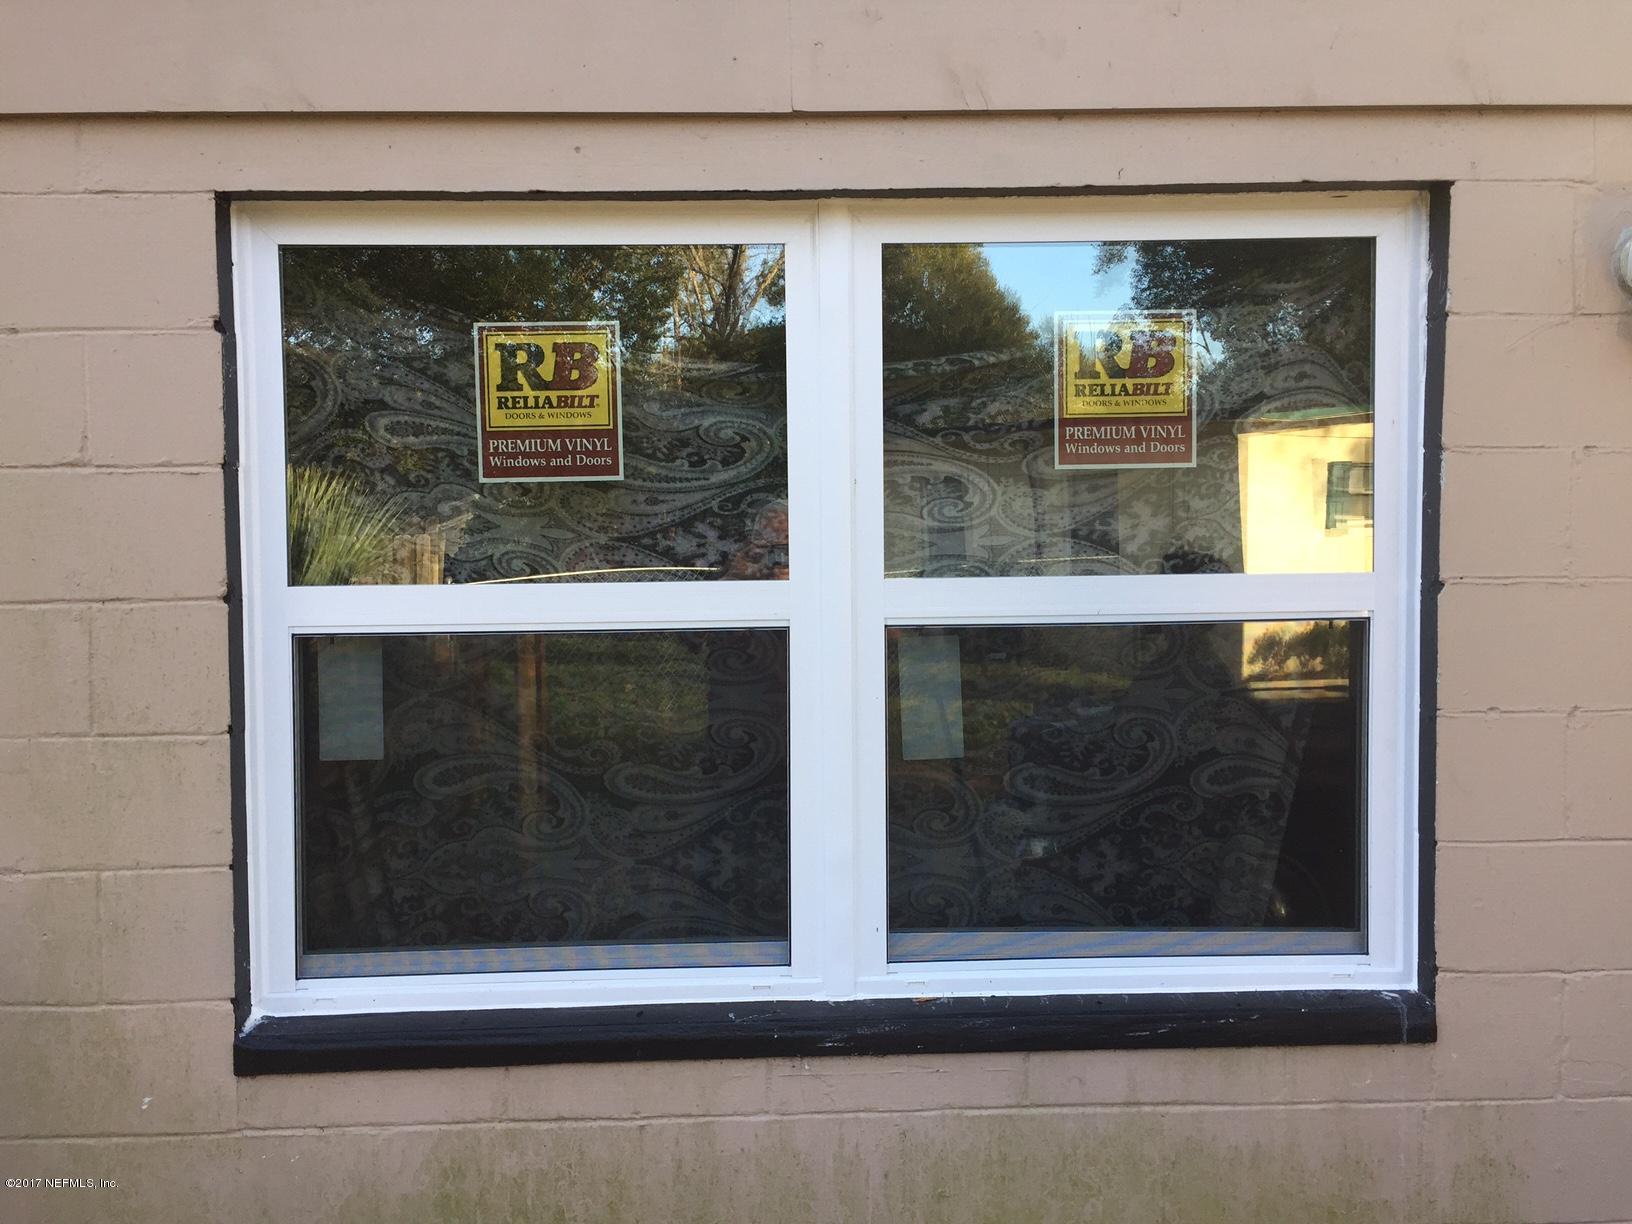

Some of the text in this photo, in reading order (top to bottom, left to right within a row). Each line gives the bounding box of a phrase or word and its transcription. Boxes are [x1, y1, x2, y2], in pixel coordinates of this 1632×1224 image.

[1074, 330, 1177, 380] RB
[495, 341, 600, 392] RB
[1074, 382, 1173, 398] RELIABILT
[496, 394, 599, 410] RELIABILT
[1122, 399, 1167, 407] WINDOWS
[505, 412, 536, 420] DOORS
[547, 411, 592, 419] WINDOWS
[1065, 425, 1185, 440] PREMIUM VINYL
[489, 438, 612, 453] PREMIUM VINYL
[1065, 441, 1185, 454] Windows and Doors
[489, 454, 612, 467] Windows and Doors
